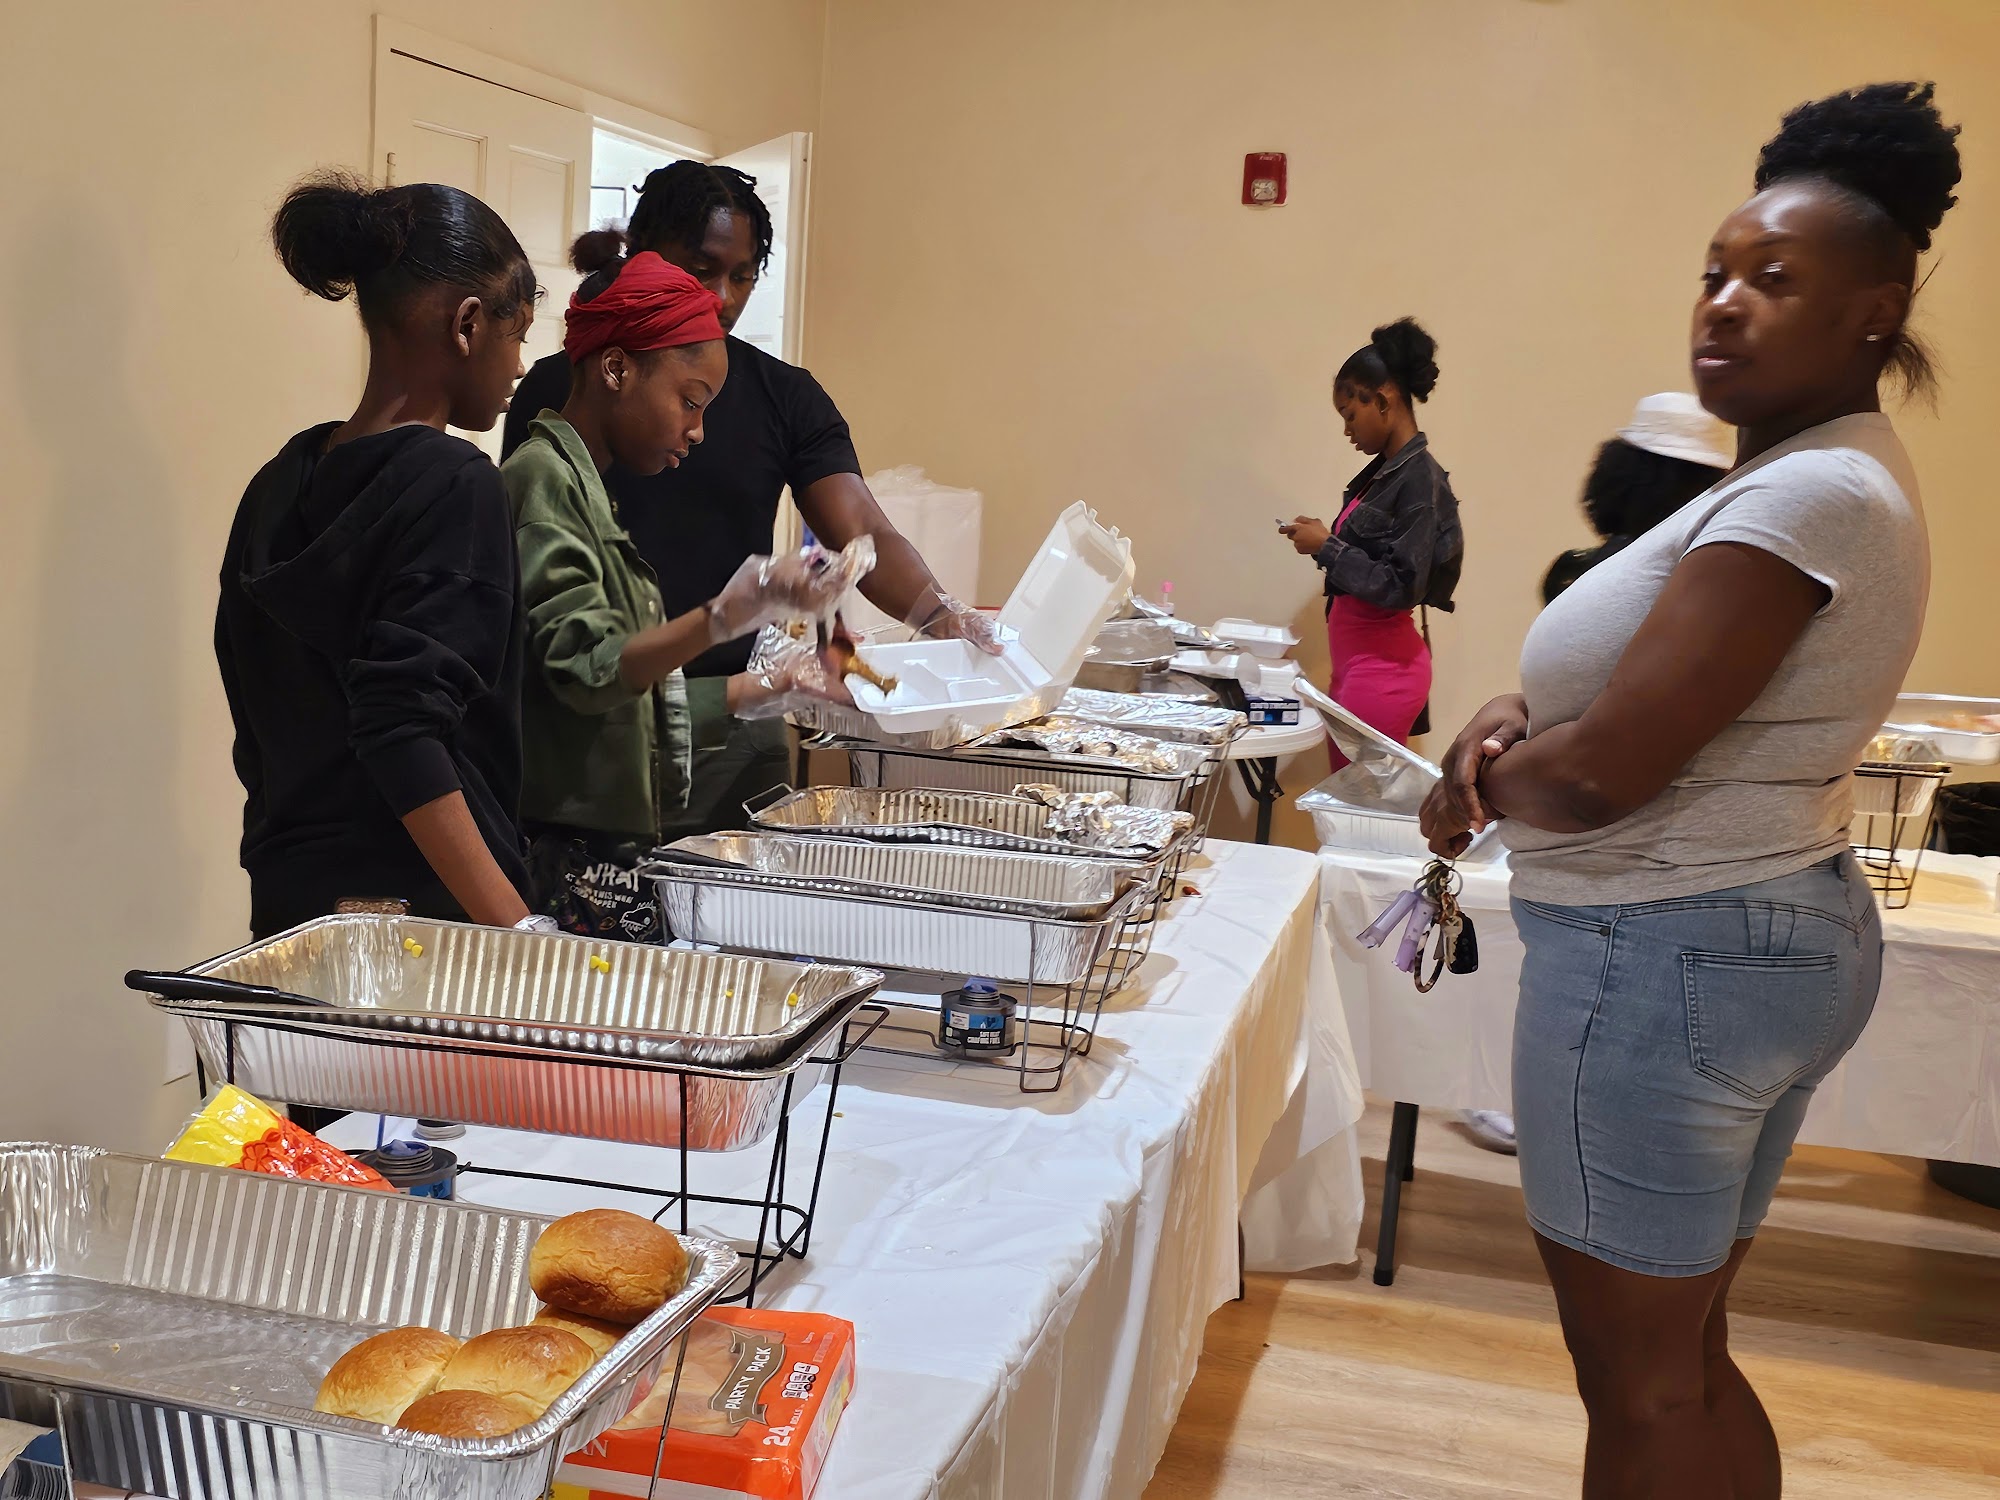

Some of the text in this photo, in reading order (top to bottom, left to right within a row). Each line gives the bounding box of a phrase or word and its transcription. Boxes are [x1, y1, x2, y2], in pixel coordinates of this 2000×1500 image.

[725, 1347, 771, 1409] PARTY PACK
[763, 1425, 795, 1446] 24
